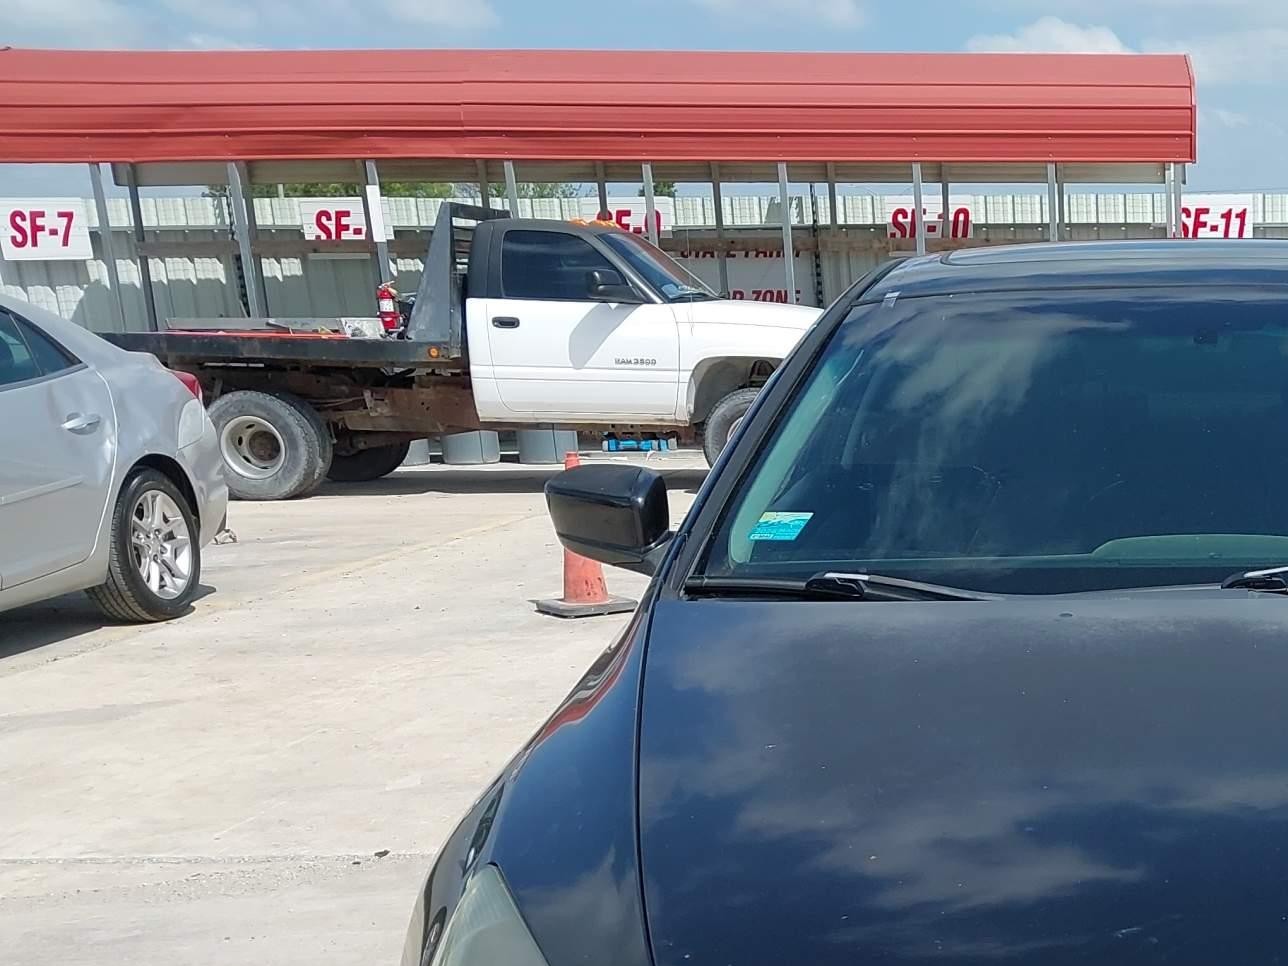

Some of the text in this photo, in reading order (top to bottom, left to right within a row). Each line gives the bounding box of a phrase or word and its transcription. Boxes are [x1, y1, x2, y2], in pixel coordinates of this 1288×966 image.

[9, 210, 74, 249] SF-7
[315, 210, 368, 240] SF-
[889, 207, 970, 239] SF-0
